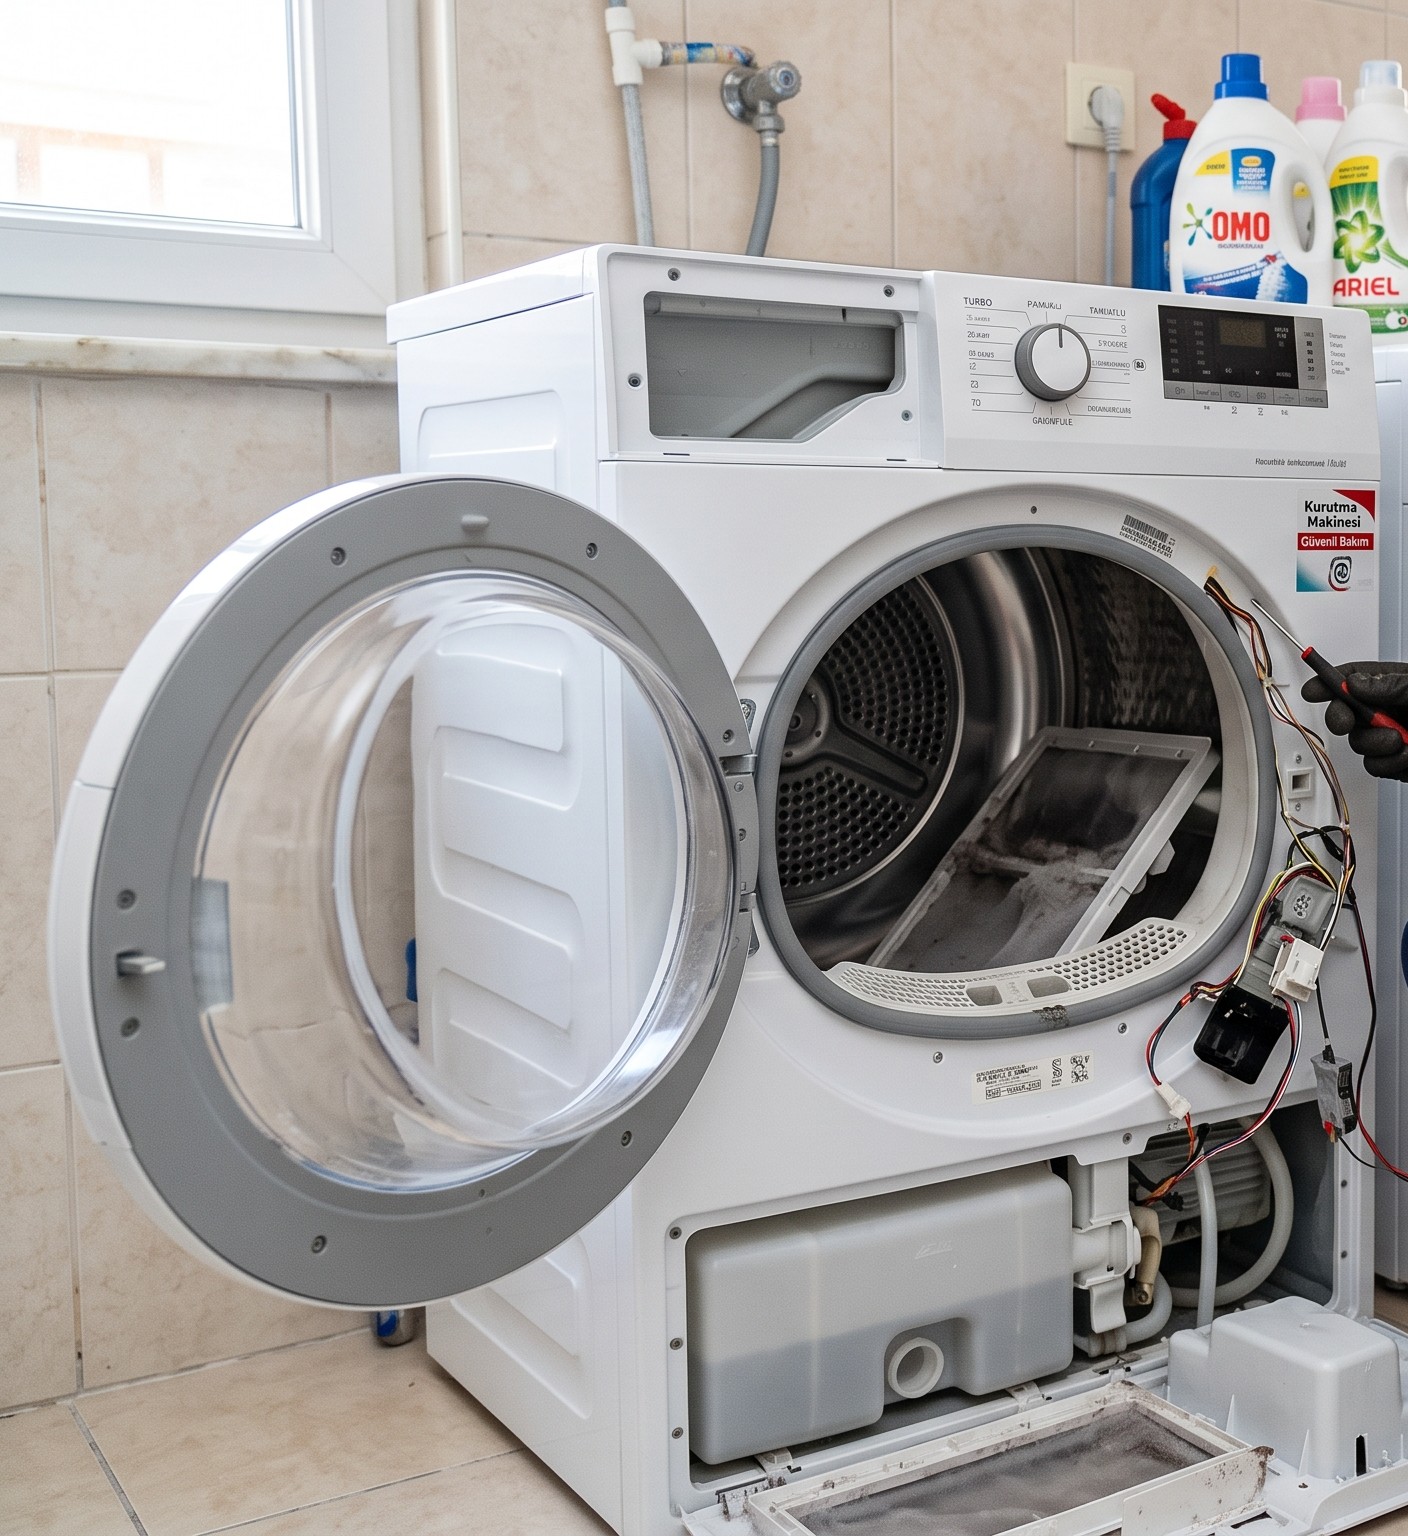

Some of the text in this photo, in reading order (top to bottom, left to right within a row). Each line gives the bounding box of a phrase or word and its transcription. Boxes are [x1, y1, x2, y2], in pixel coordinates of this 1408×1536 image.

[1212, 211, 1270, 241] OMO
[1333, 277, 1400, 297] ARIEL
[963, 296, 993, 307] TURBO
[1304, 500, 1357, 513] Kurutma
[1307, 515, 1361, 528] Makinesi
[1339, 535, 1369, 547] Bakım
